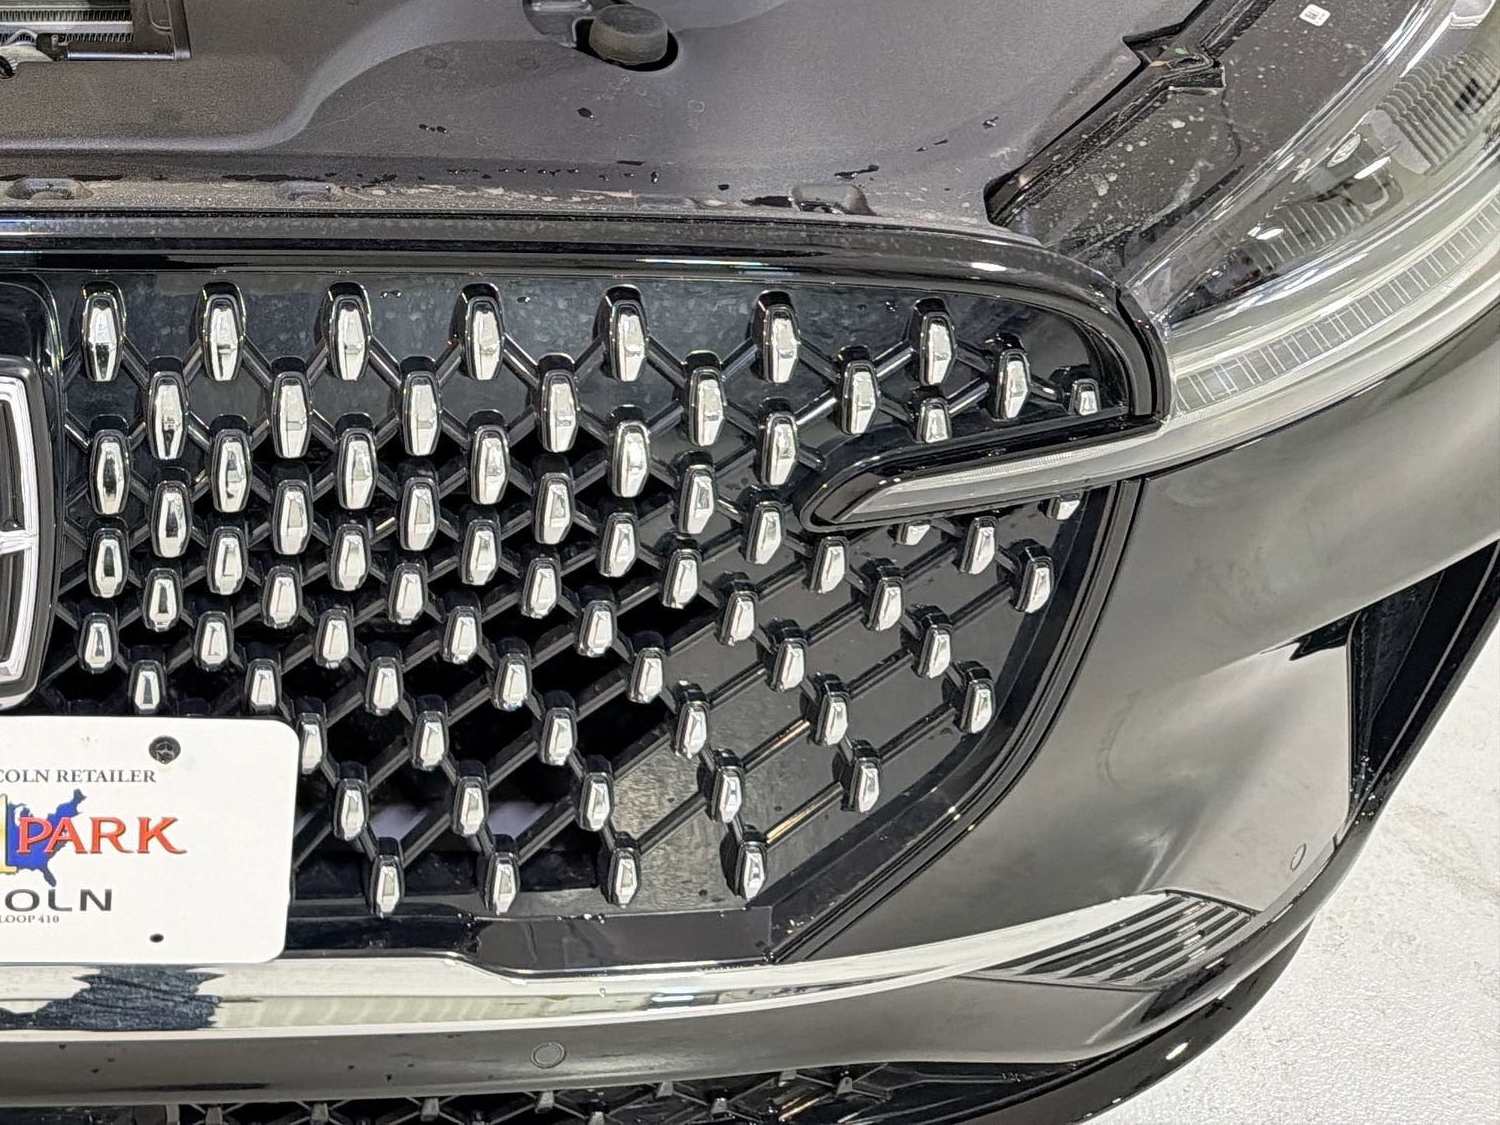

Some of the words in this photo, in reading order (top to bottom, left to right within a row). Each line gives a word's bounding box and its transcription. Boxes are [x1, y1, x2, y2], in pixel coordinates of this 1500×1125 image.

[55, 769, 156, 784] RETAILER
[17, 816, 188, 856] PARK
[38, 914, 60, 924] 410
